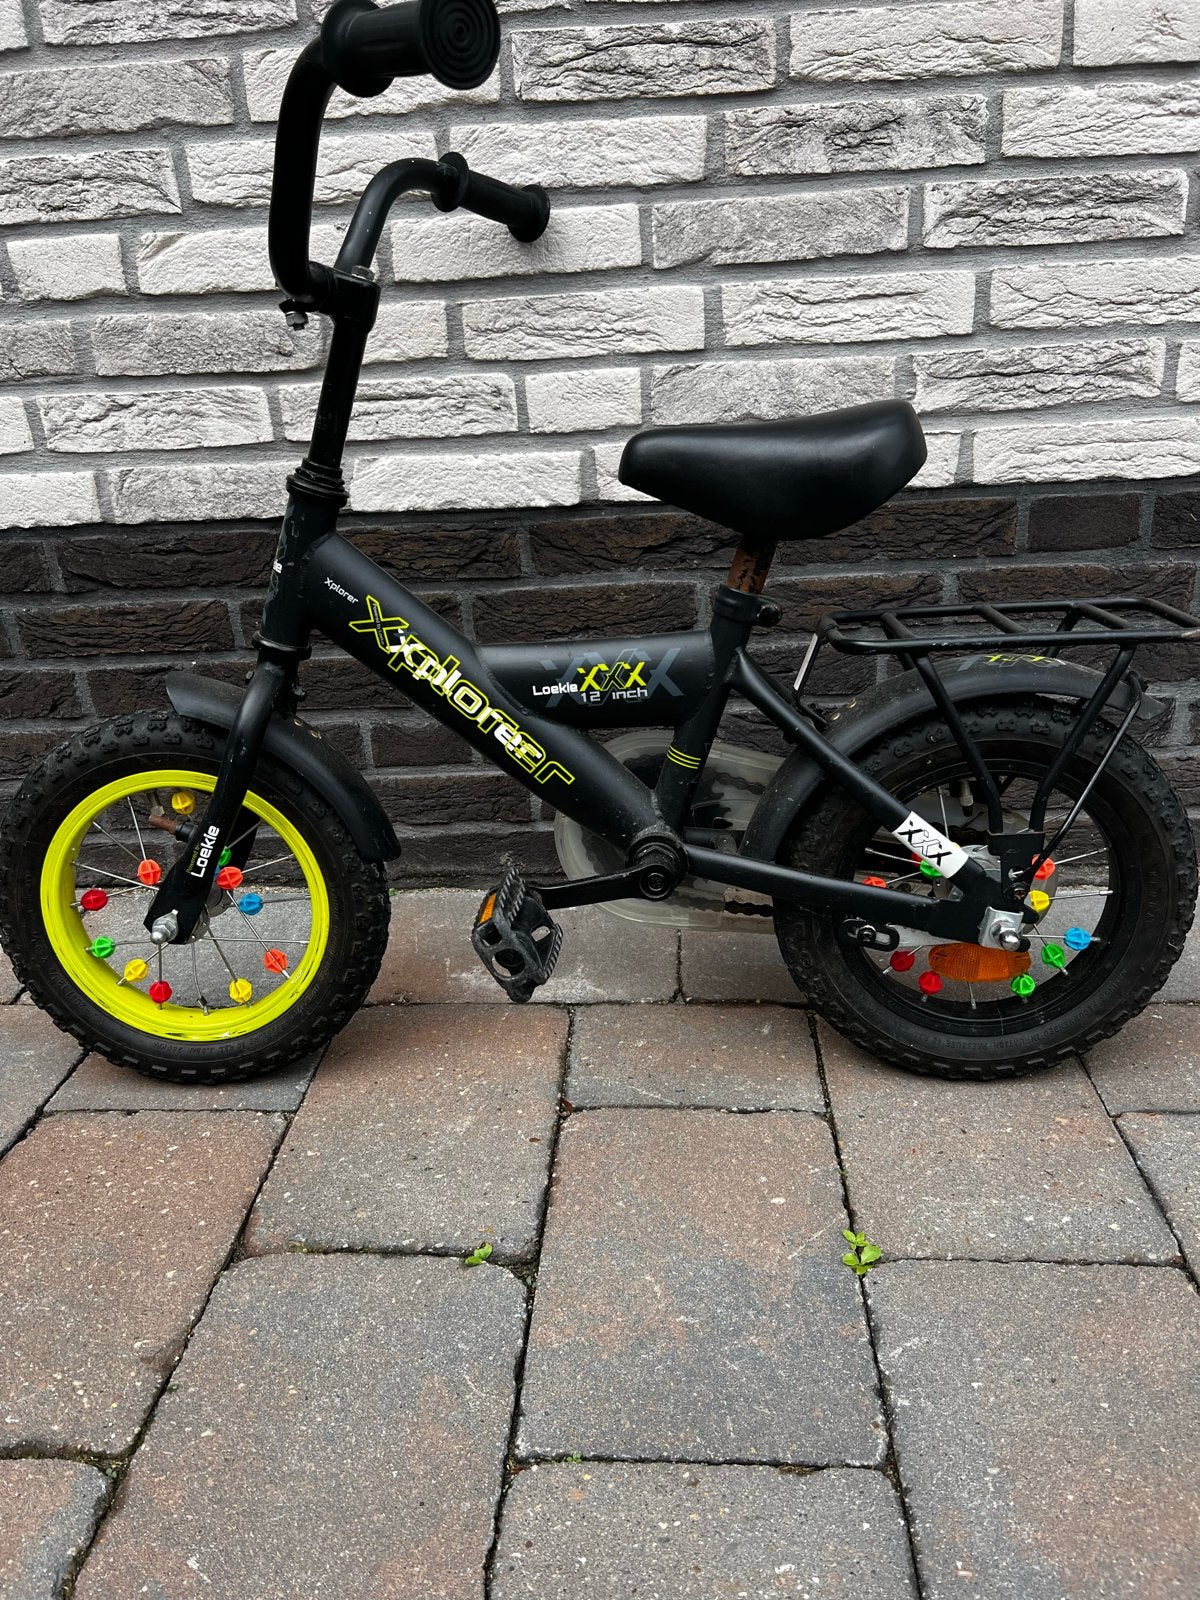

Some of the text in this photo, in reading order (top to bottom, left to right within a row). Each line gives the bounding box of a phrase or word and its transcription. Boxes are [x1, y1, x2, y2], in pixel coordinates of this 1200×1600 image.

[324, 577, 359, 604] Xplorer
[348, 594, 576, 785] Xplorer
[580, 687, 648, 703] 12 inch
[190, 825, 220, 878] Loekie
